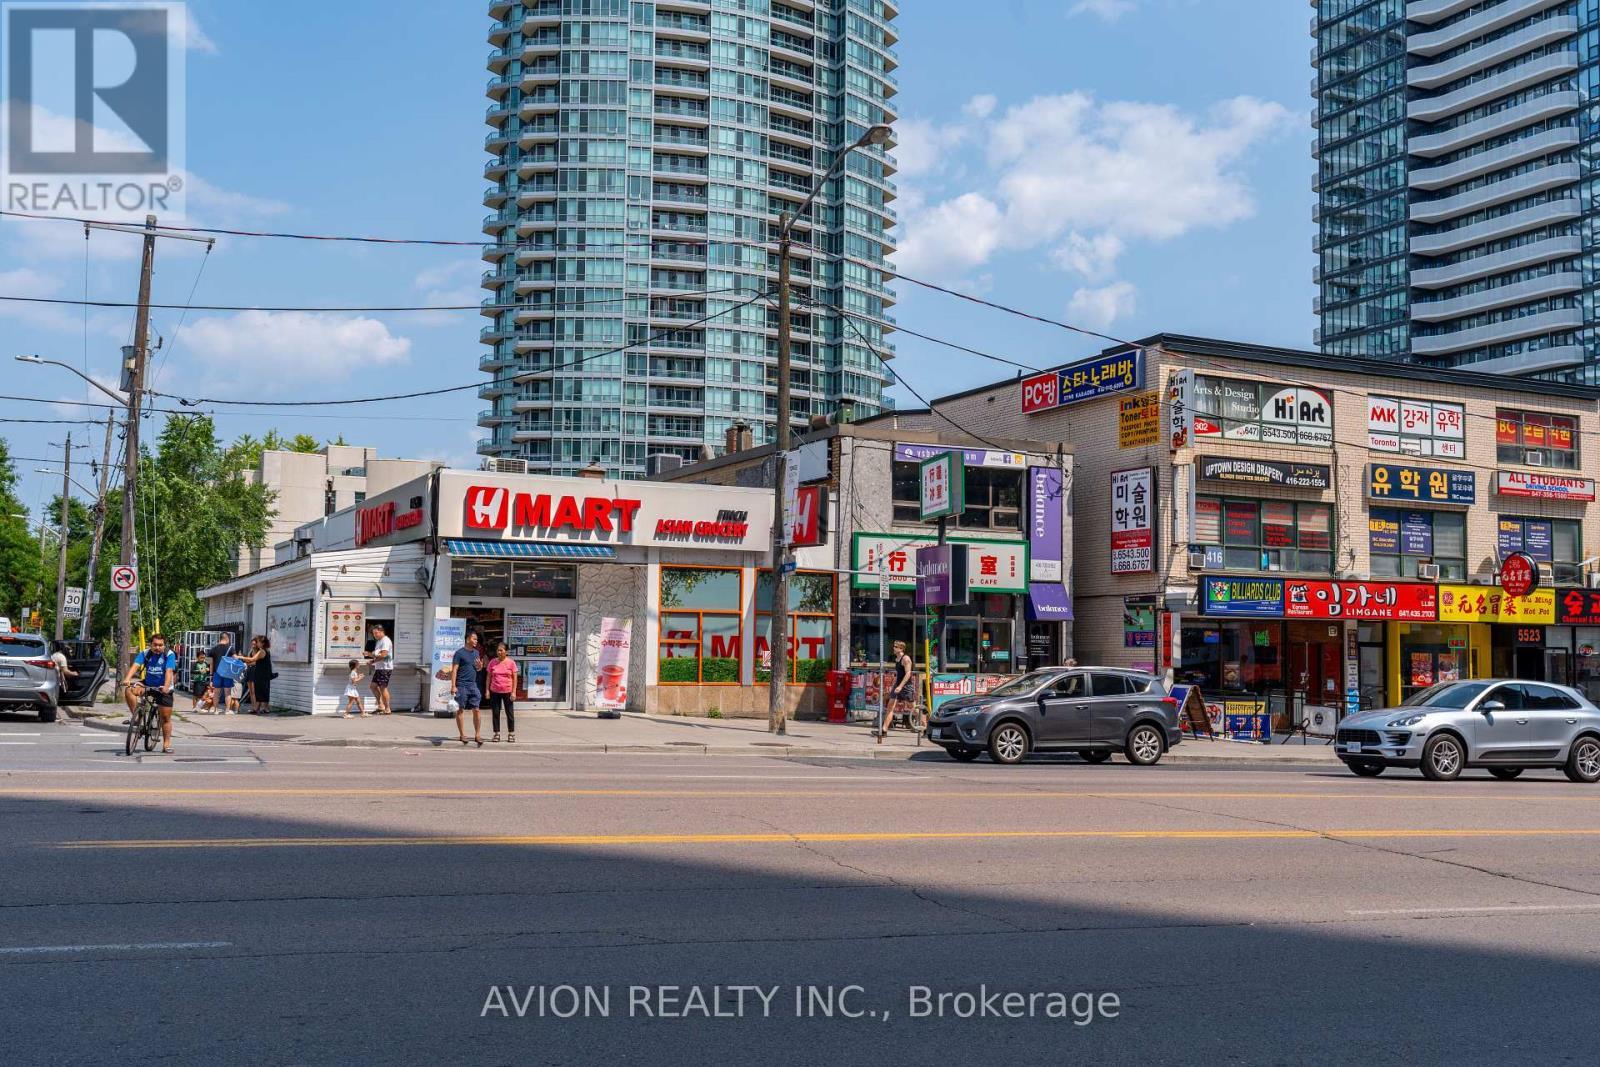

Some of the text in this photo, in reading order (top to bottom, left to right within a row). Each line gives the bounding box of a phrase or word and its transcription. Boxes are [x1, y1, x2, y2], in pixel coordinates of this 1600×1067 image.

[1024, 379, 1056, 407] PC방
[1193, 384, 1255, 400] Arts & Design
[1231, 401, 1260, 414] Studio
[1274, 396, 1325, 423] Hi Art
[1194, 423, 1208, 432] 302
[1370, 407, 1460, 433] MK 감자 유학
[1371, 437, 1397, 447] Toronto
[1441, 443, 1456, 454] 센터
[1205, 461, 1283, 483] UPTOWN DESIGN DRAPERY
[1285, 476, 1326, 487] 416-222-1554
[1371, 467, 1449, 499] 유학원
[1508, 472, 1585, 489] ALL ETUDIANTS
[1525, 483, 1568, 493] DRIVING SCHOOL
[1116, 481, 1147, 505] 미술
[514, 492, 642, 532] MART
[1035, 473, 1046, 538] balance
[717, 509, 748, 523] FINCH
[1115, 504, 1147, 529] 학원
[656, 518, 749, 539] ASIAN GROCERY
[888, 551, 907, 572] 行
[980, 555, 998, 576] 室
[1206, 551, 1223, 563] 416
[919, 560, 948, 576] balance
[1231, 582, 1281, 600] BILLIARDS CLUB
[66, 595, 81, 605] 30
[1316, 582, 1397, 617] 임가네
[1535, 596, 1553, 606] Ming
[1037, 604, 1068, 613] balance
[1287, 608, 1313, 616] Restaurant
[1346, 608, 1393, 617] LIMGANE
[1523, 608, 1550, 616] Hot Pot
[1518, 629, 1541, 642] 5523
[601, 639, 630, 649] 수박주스
[959, 679, 972, 695] 10
